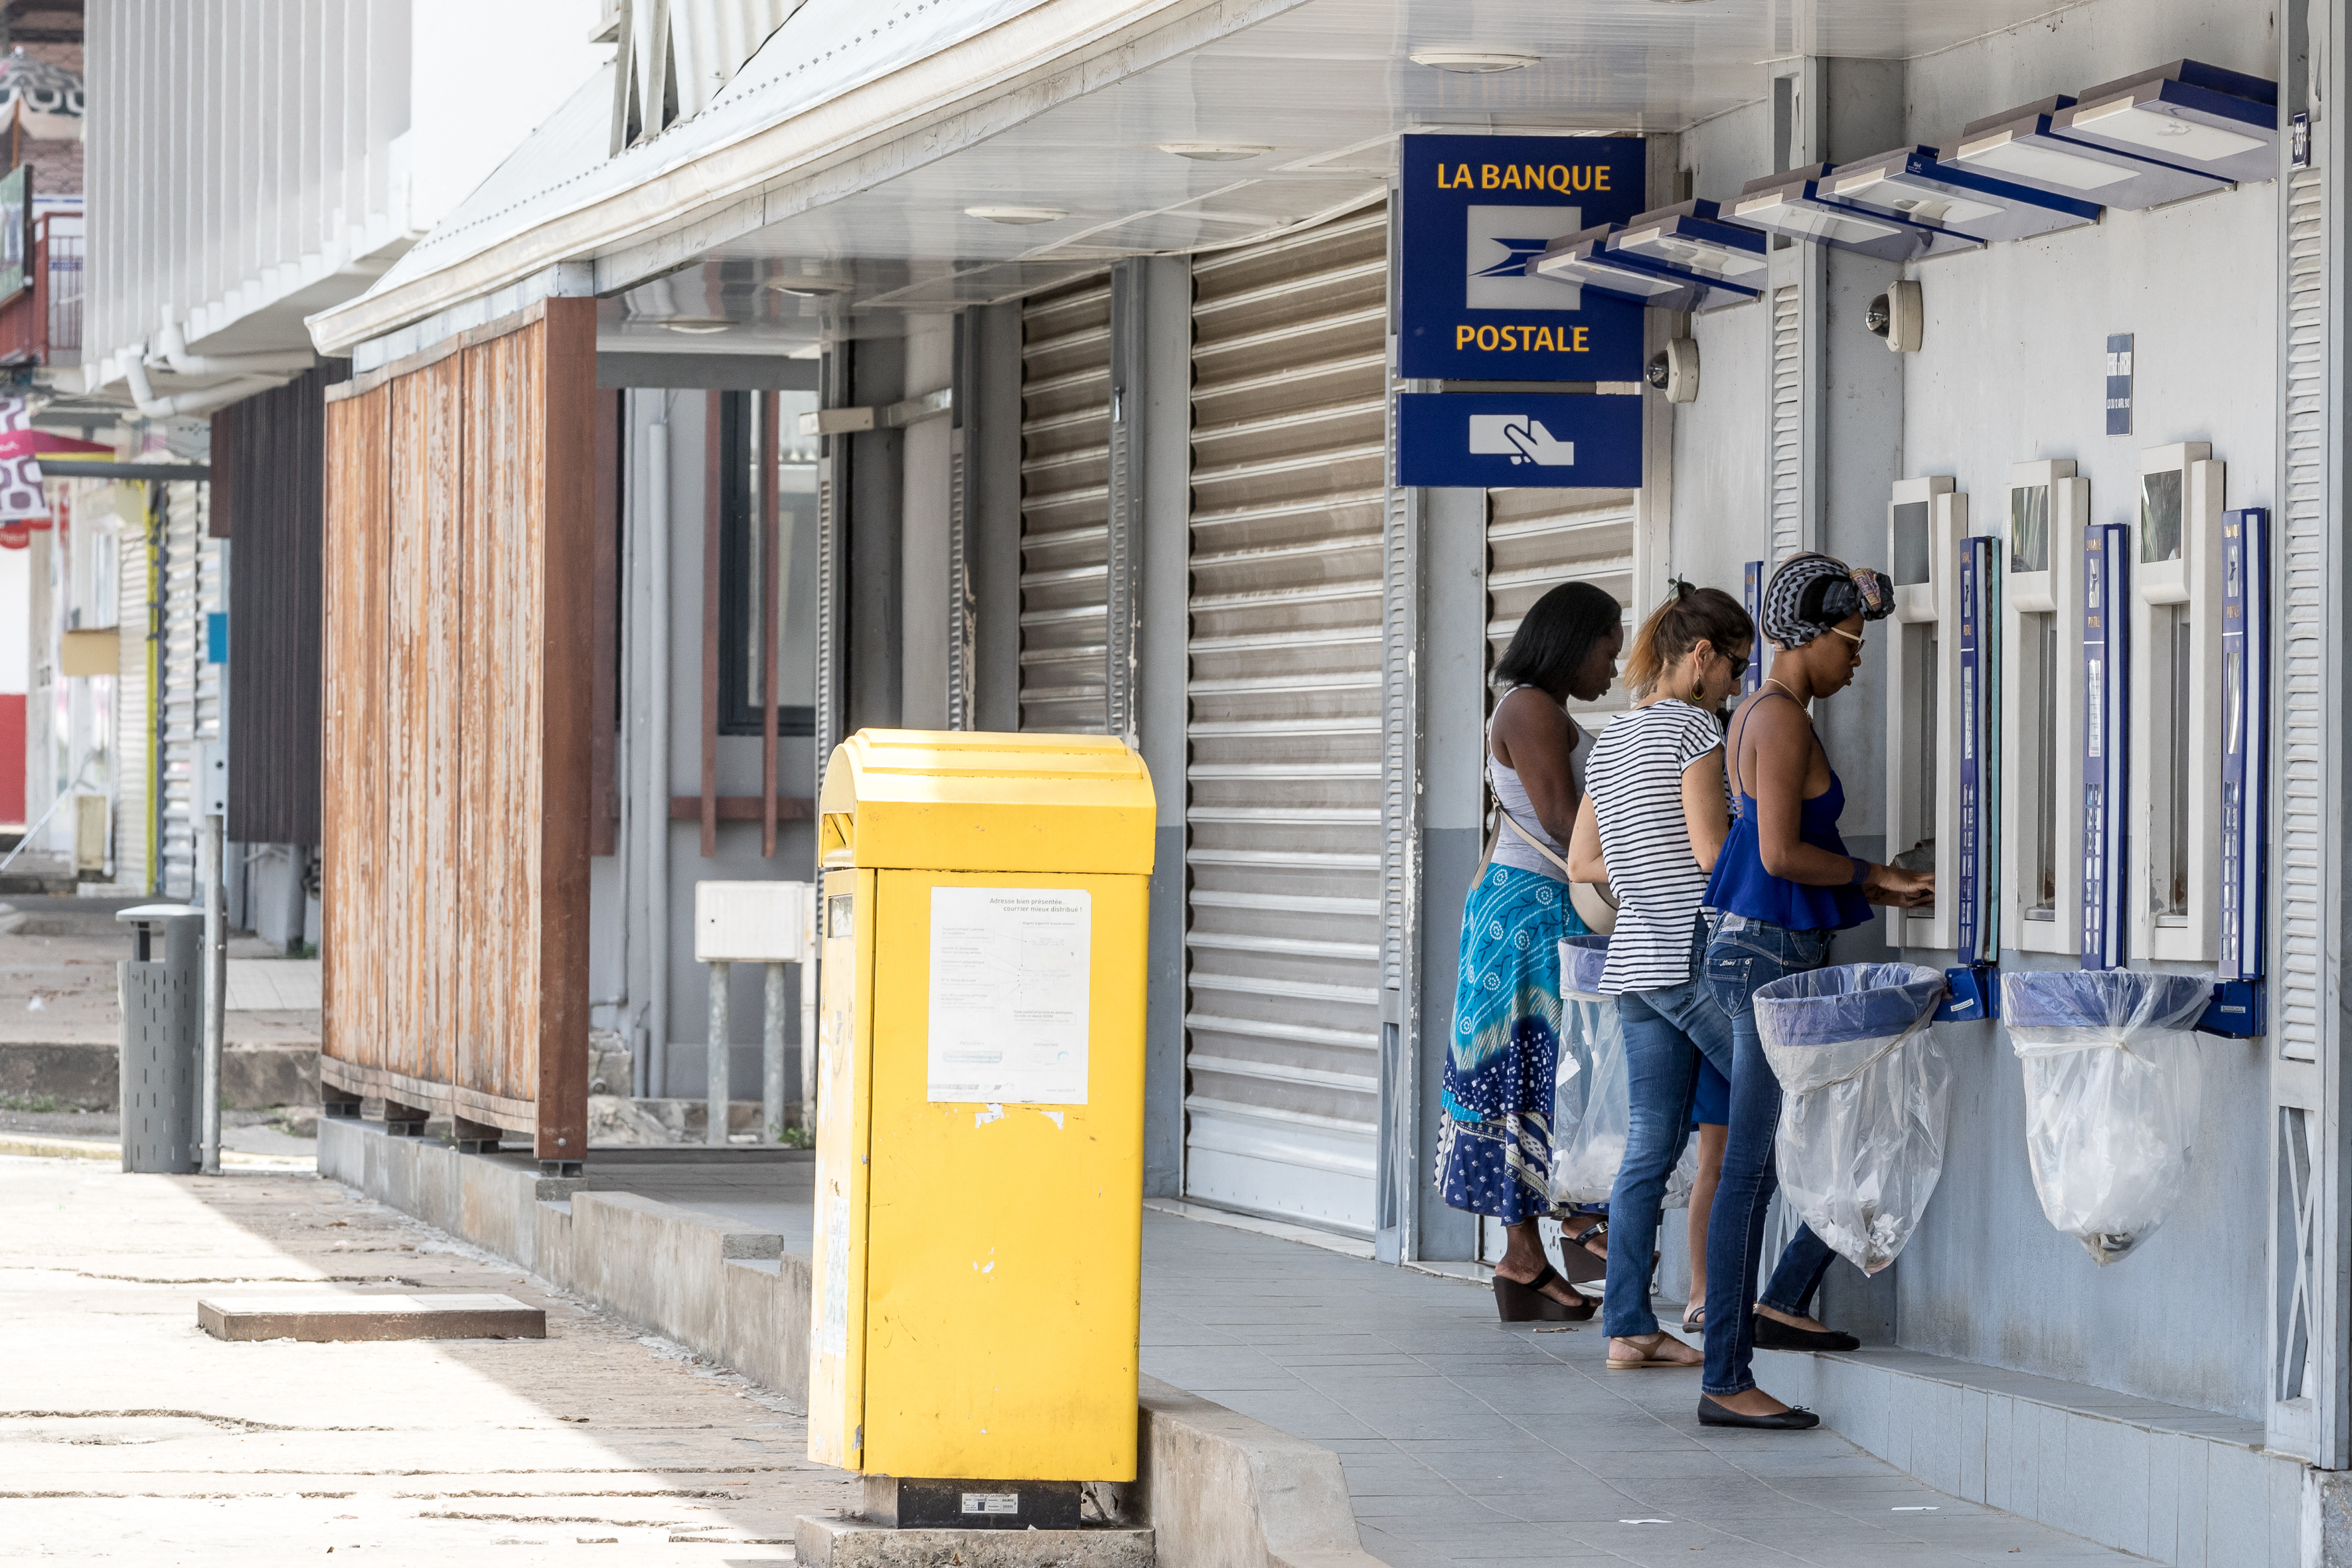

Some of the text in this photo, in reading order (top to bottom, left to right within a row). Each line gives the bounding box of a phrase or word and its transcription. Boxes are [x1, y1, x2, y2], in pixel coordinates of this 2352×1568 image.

[2295, 123, 2303, 155] 33
[1437, 163, 1611, 194] LA BANQUE
[1456, 325, 1589, 352] POSTALE
